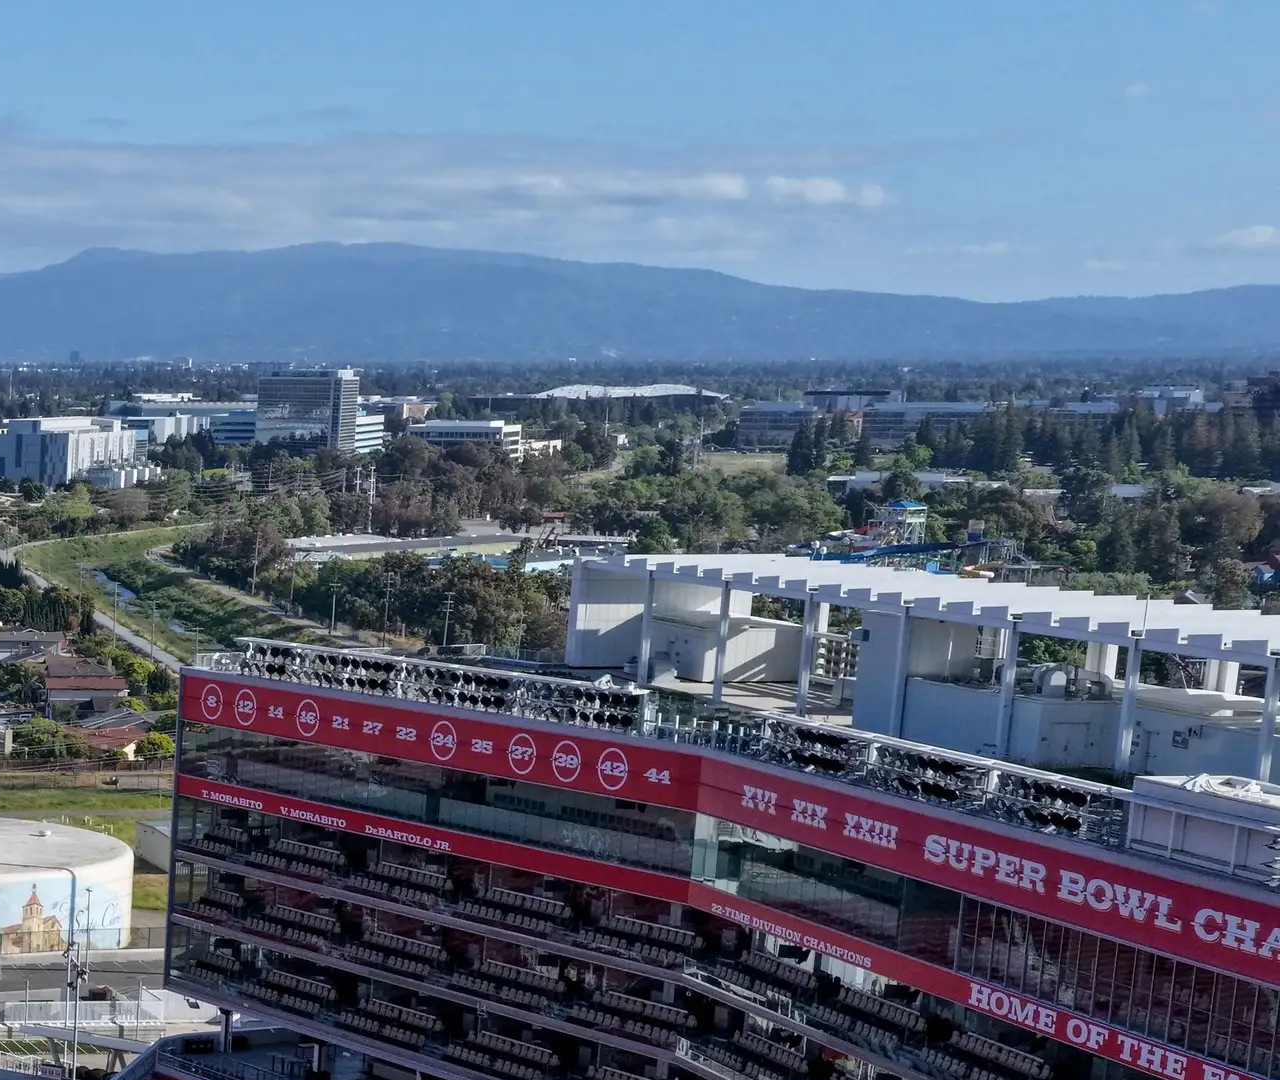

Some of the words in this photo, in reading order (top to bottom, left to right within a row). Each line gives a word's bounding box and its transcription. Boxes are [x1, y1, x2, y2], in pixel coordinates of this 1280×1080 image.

[207, 695, 216, 707] 8
[237, 700, 253, 714] 12
[268, 706, 284, 719] 14
[300, 710, 316, 724] 16
[332, 715, 350, 730] 21
[363, 720, 384, 735] 27
[396, 726, 416, 742] 33
[434, 732, 454, 748] 34
[471, 739, 493, 755] 35
[511, 744, 533, 760] 37
[600, 760, 625, 776] 42
[643, 768, 671, 785] 44
[280, 806, 289, 816] V.
[290, 809, 346, 828] MORABITO
[741, 785, 778, 815] XVI
[790, 798, 828, 831] XIX
[843, 812, 899, 850] XXIII
[432, 839, 452, 851] JR.
[923, 834, 1047, 895] SUPER
[1057, 868, 1183, 933] BOWL
[711, 903, 750, 924] 22-TIME
[751, 917, 802, 943] DIVISION
[803, 936, 872, 967] CHAMPIONS
[968, 982, 1056, 1034] HOME
[1066, 1018, 1108, 1049] OF
[1117, 1034, 1187, 1080] THE
